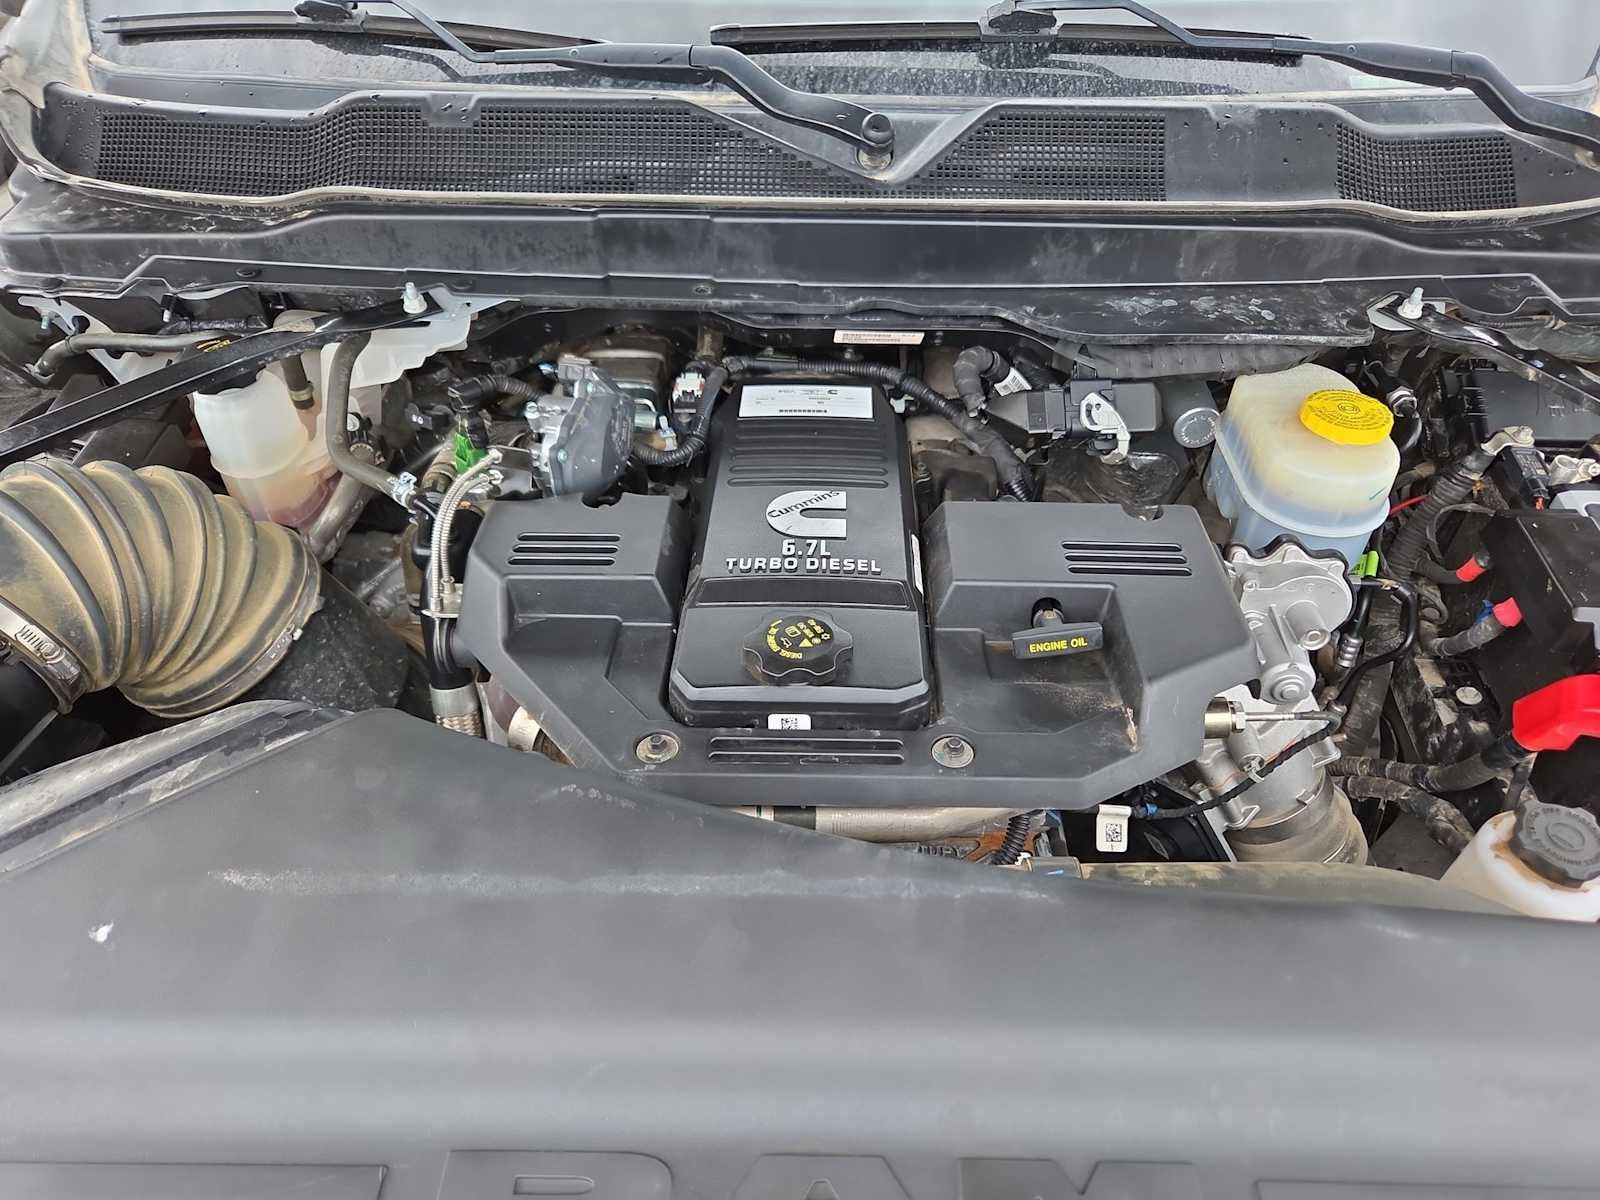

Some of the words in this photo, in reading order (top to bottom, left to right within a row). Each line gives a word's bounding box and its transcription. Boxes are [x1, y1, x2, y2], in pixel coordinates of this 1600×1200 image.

[767, 490, 840, 518] Cummins
[781, 539, 832, 556] 6.7L
[725, 557, 798, 573] TURBO
[806, 557, 882, 574] DIESEL
[1029, 640, 1068, 653] ENGINE
[1070, 637, 1088, 648] OIL
